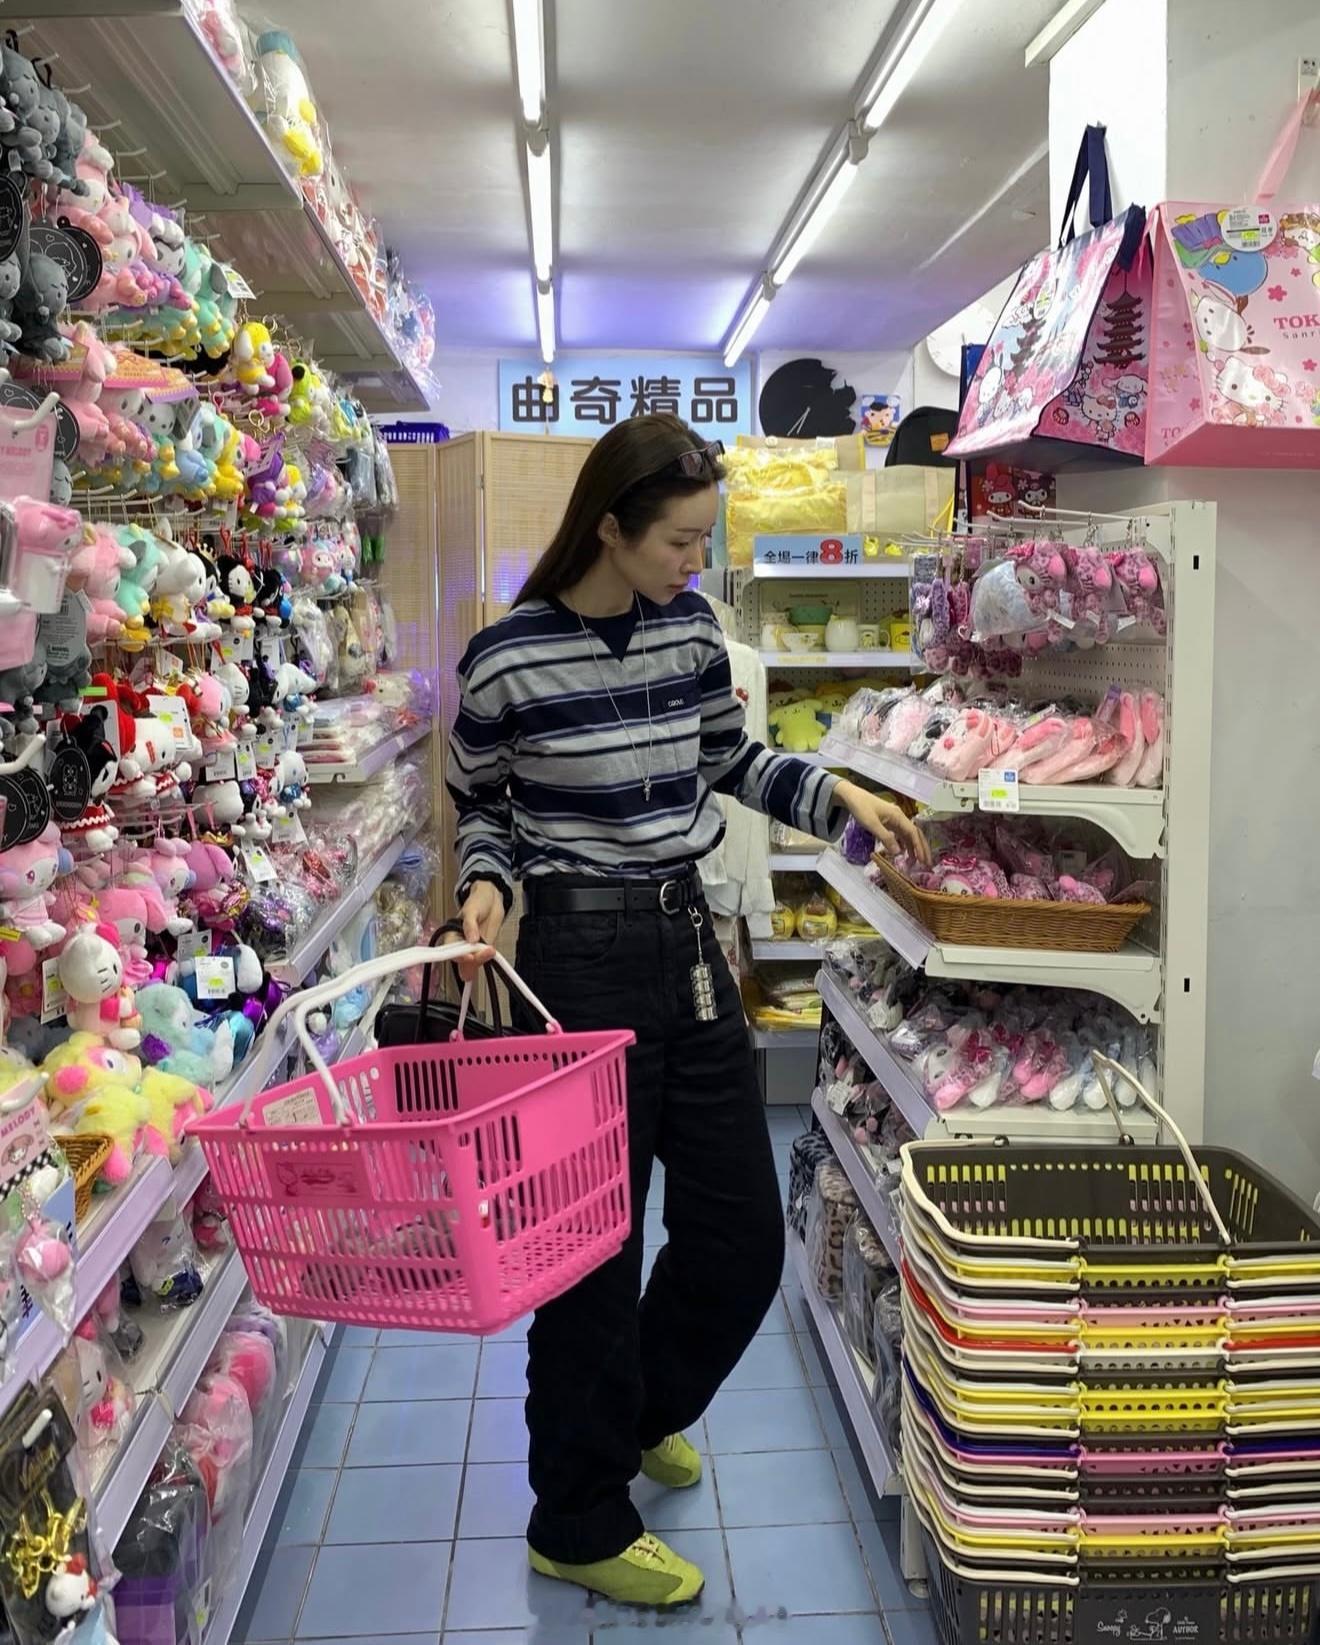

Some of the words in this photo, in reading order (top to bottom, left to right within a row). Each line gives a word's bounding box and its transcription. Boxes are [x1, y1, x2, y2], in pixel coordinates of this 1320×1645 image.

[512, 375, 738, 424] 曲奇精品
[1, 1105, 36, 1137] MELODY
